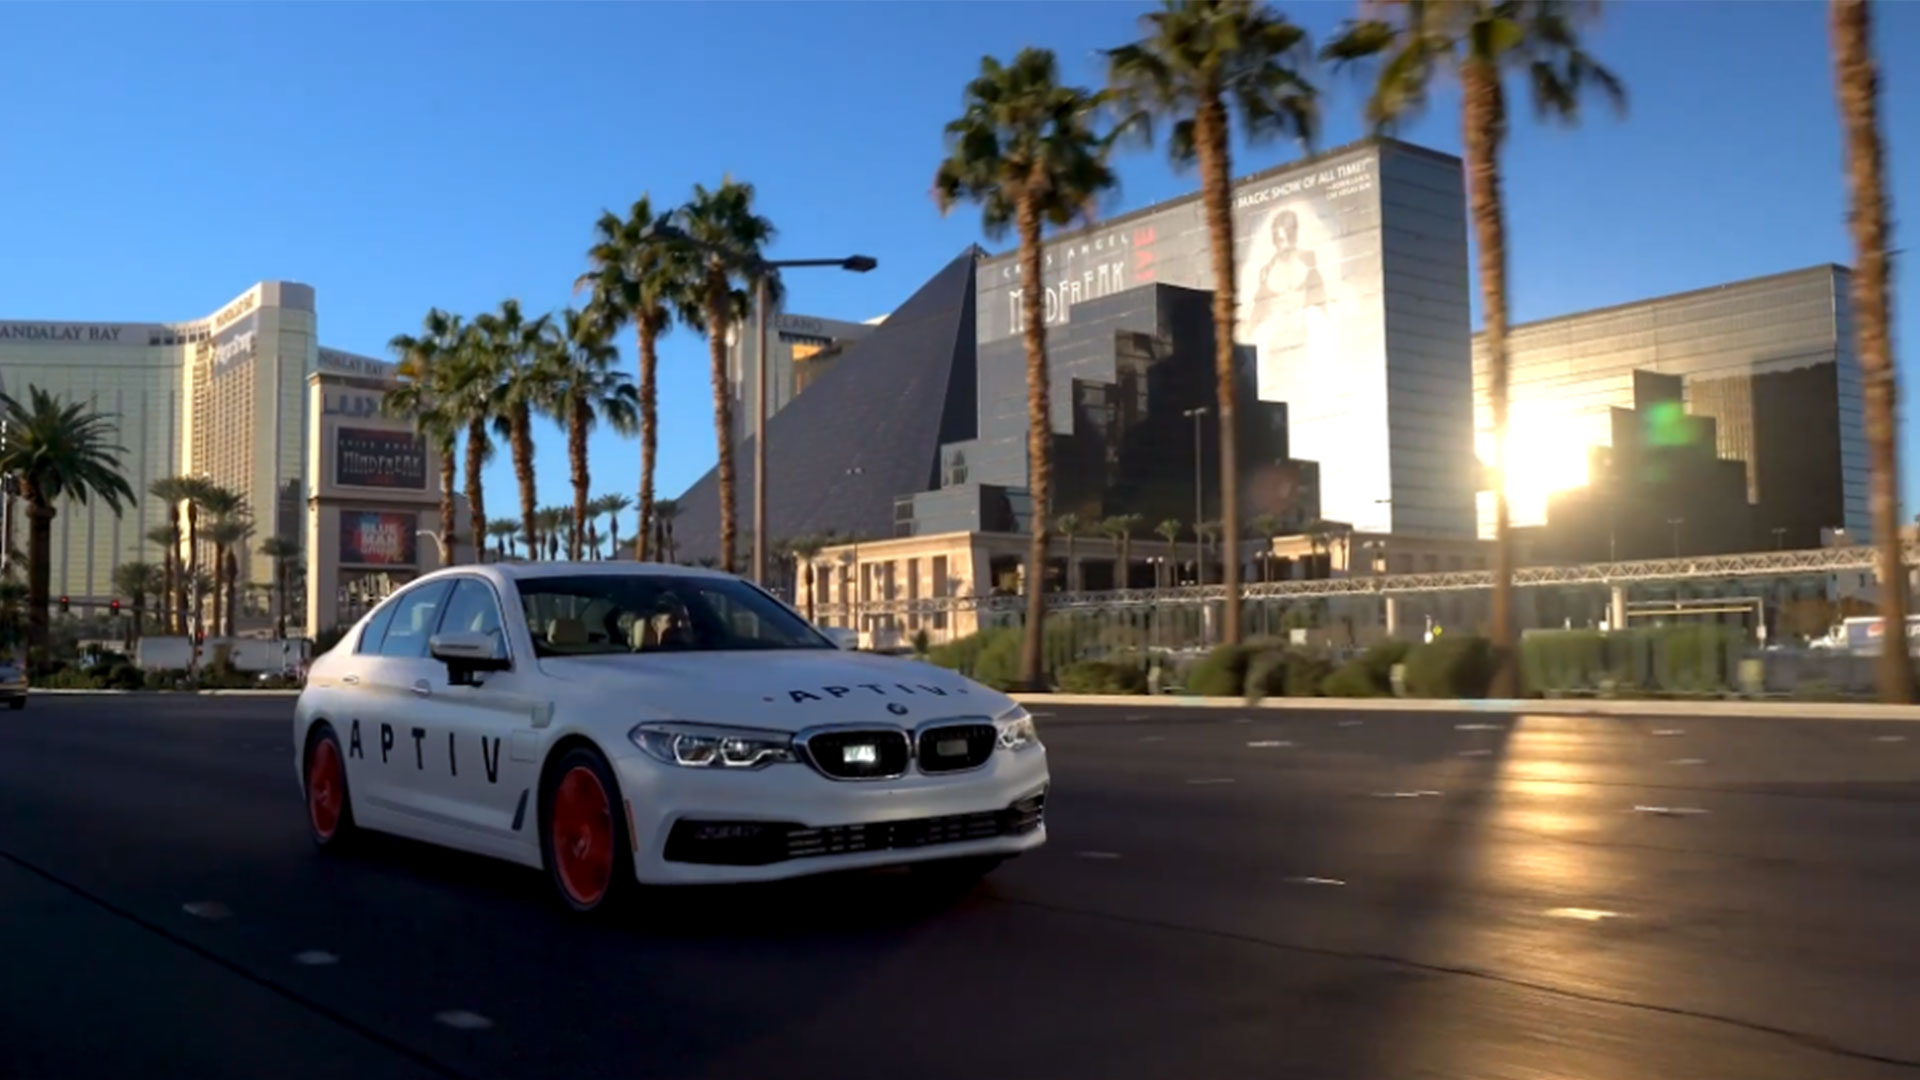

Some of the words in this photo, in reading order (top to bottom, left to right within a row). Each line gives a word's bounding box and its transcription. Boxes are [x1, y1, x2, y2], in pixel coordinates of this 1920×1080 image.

[1238, 188, 1269, 208] MAGIC
[1271, 180, 1301, 199] SHOW
[1303, 174, 1317, 189] OF
[1318, 169, 1336, 185] ALL
[89, 326, 121, 341] BAY
[788, 683, 949, 703] APTIV
[349, 718, 501, 784] APTIV
